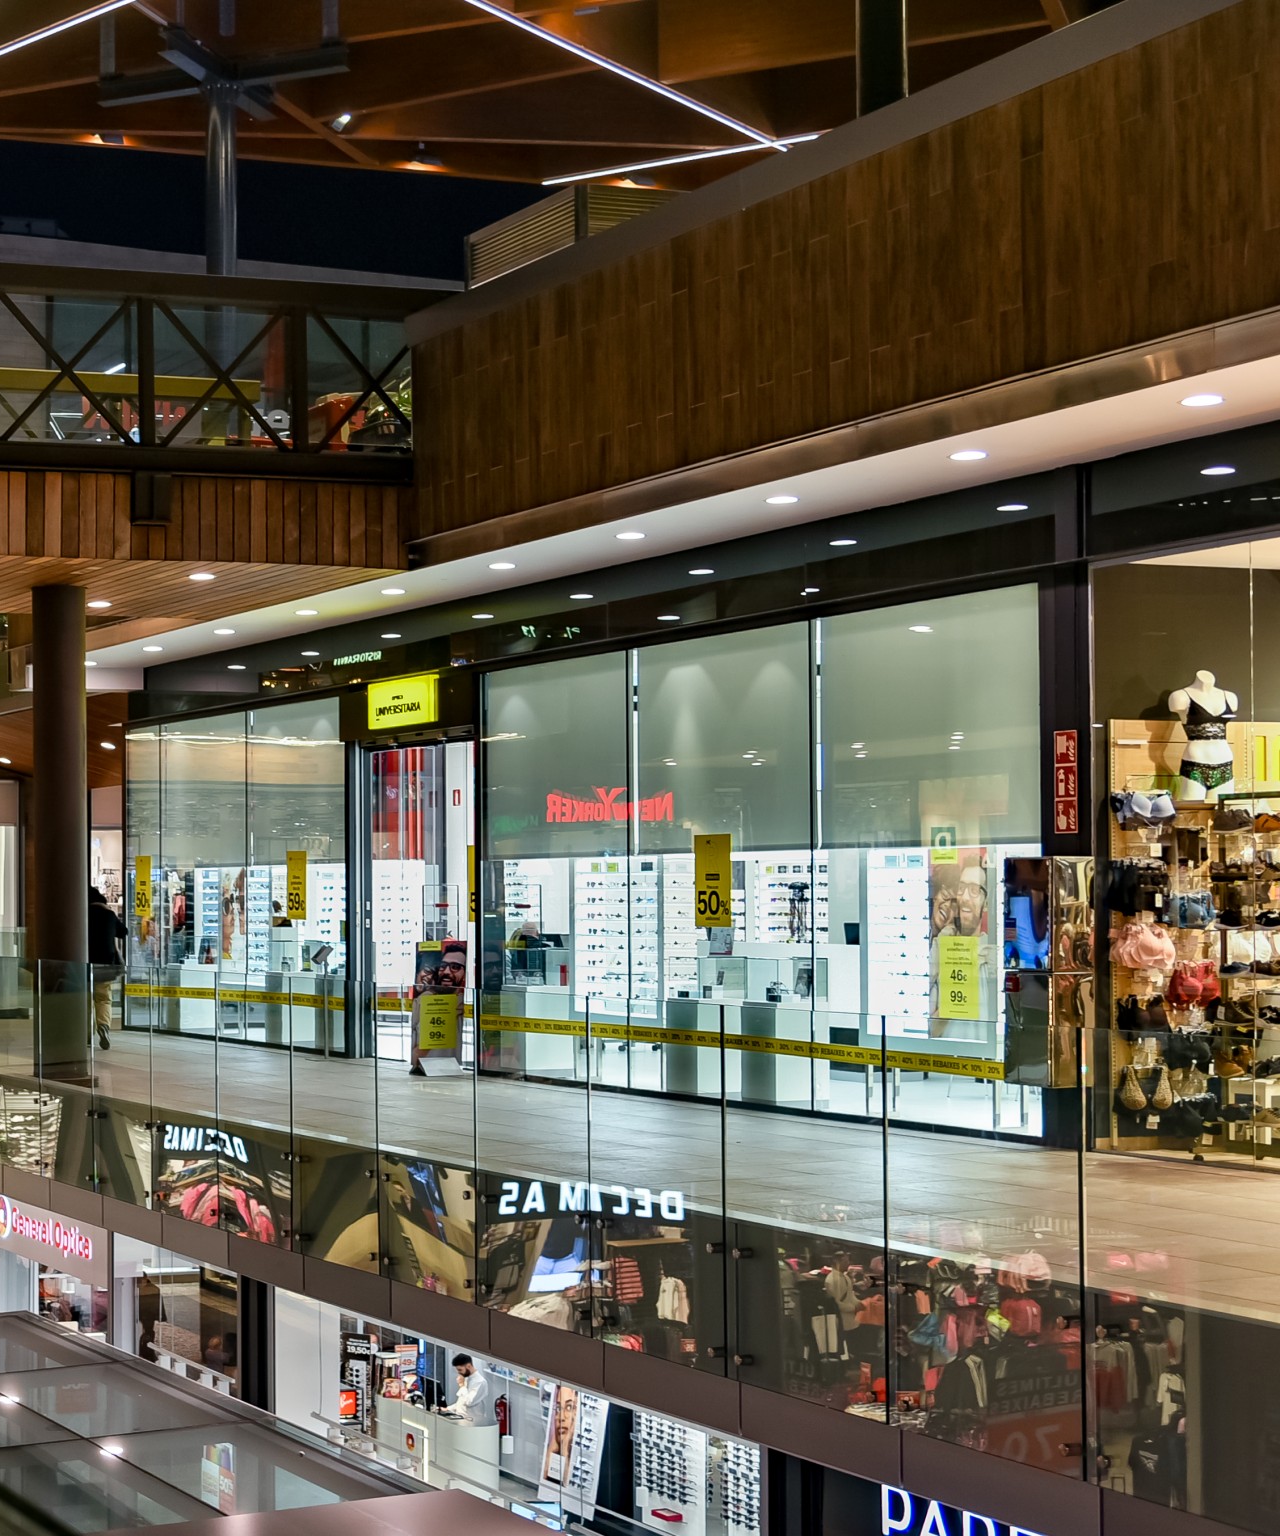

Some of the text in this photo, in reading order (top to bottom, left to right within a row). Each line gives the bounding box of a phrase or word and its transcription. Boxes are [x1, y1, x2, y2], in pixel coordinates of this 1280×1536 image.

[376, 702, 421, 717] UNIVERSITARIA
[698, 890, 729, 915] 50%
[950, 969, 967, 982] 46€
[950, 990, 967, 1004] 99€
[901, 1056, 914, 1065] 40%
[932, 1059, 960, 1070] REBAIXES
[970, 1063, 1001, 1075] 10% 20%
[12, 1206, 93, 1260] General Optica
